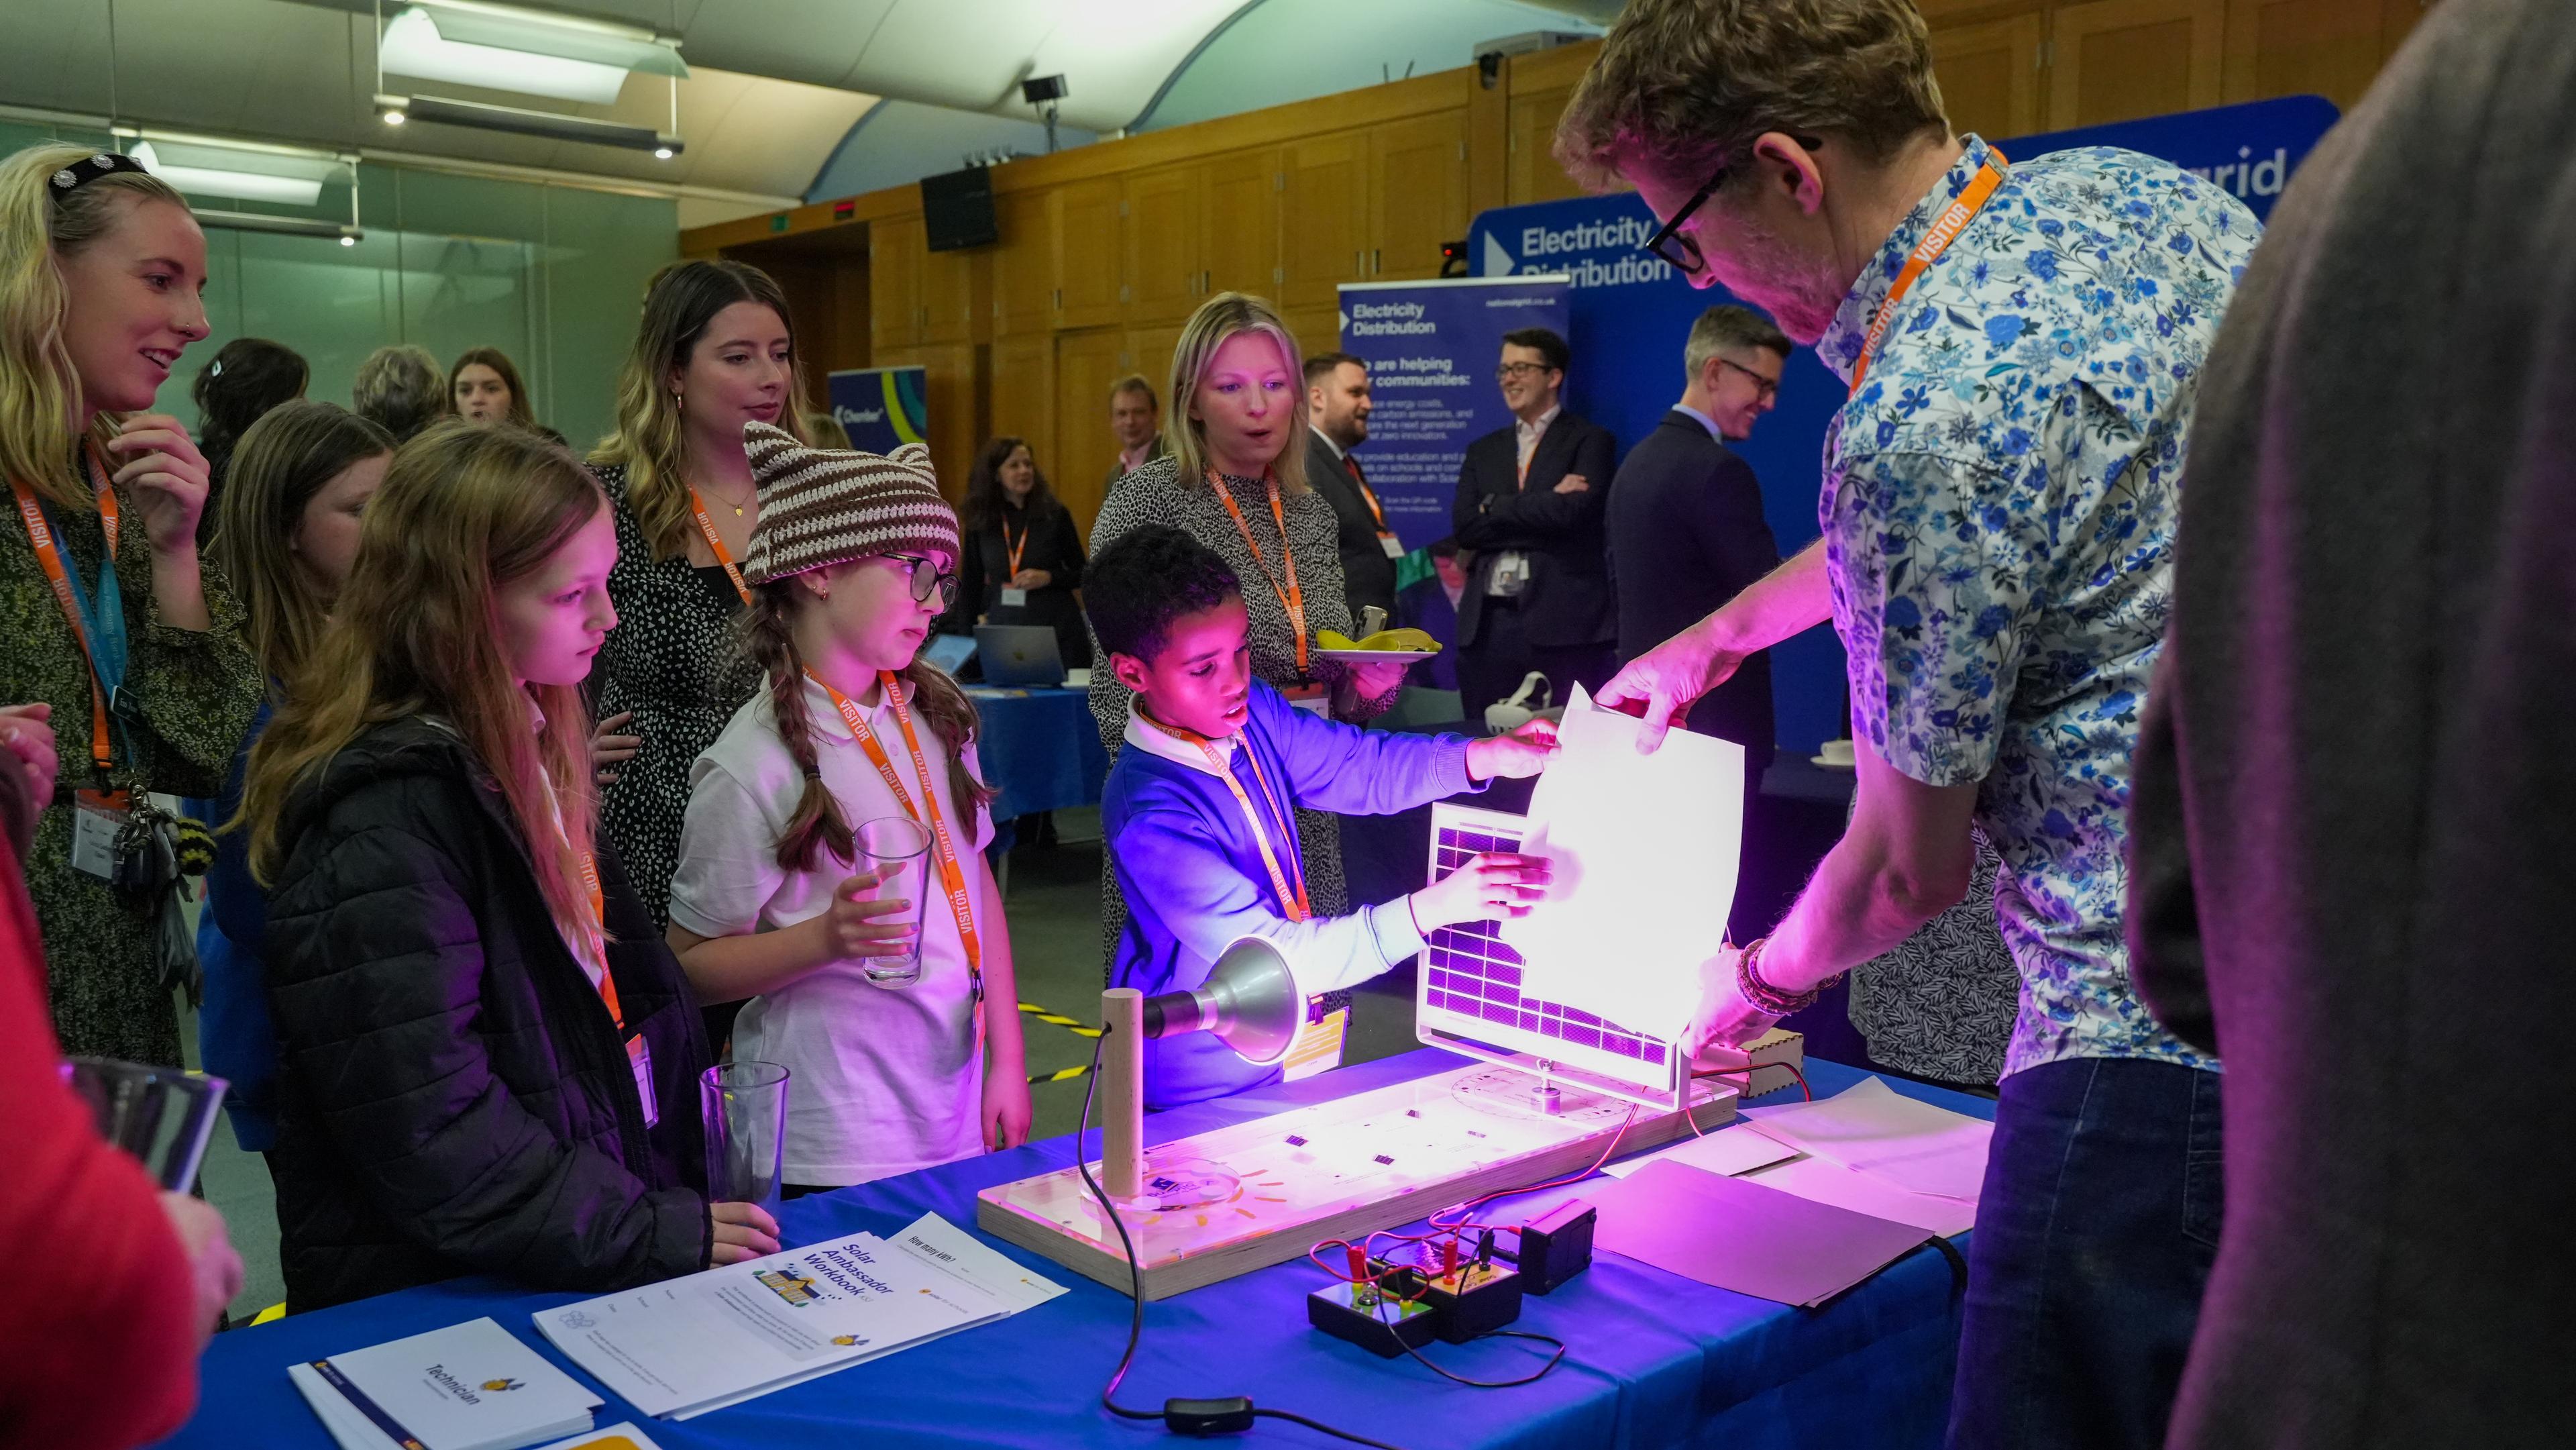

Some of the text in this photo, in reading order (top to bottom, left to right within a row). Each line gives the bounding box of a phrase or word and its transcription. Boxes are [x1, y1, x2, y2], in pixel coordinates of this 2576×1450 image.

[1522, 216, 1652, 256] Electricity
[1914, 203, 1970, 263] VISITOR
[1522, 254, 1671, 289] ribution
[1353, 303, 1424, 319] Electricity
[1353, 320, 1436, 335] Distribution
[1863, 298, 1898, 358] VISITOR
[1374, 360, 1397, 372] are
[1399, 357, 1452, 372] helping
[1376, 374, 1470, 387] communities:
[22, 499, 51, 548] VISITOR
[697, 511, 719, 545] VISITOR
[724, 561, 747, 593] VISITOR
[839, 699, 870, 742] VISITOR
[888, 682, 909, 723] VISITOR
[879, 762, 908, 803] VISITOR
[912, 751, 932, 792] VISITOR
[1203, 744, 1233, 782] VISITOR
[936, 820, 955, 862] VISITOR
[580, 850, 598, 891] SITOR
[1269, 865, 1292, 904] VISITOR
[955, 888, 973, 934] VISITOR
[843, 1243, 876, 1264] Solar
[908, 1236, 923, 1246] How
[920, 1243, 938, 1256] many
[804, 1253, 865, 1296] Workbook
[821, 1249, 894, 1294] Ambassador
[425, 1364, 480, 1406] Technician
